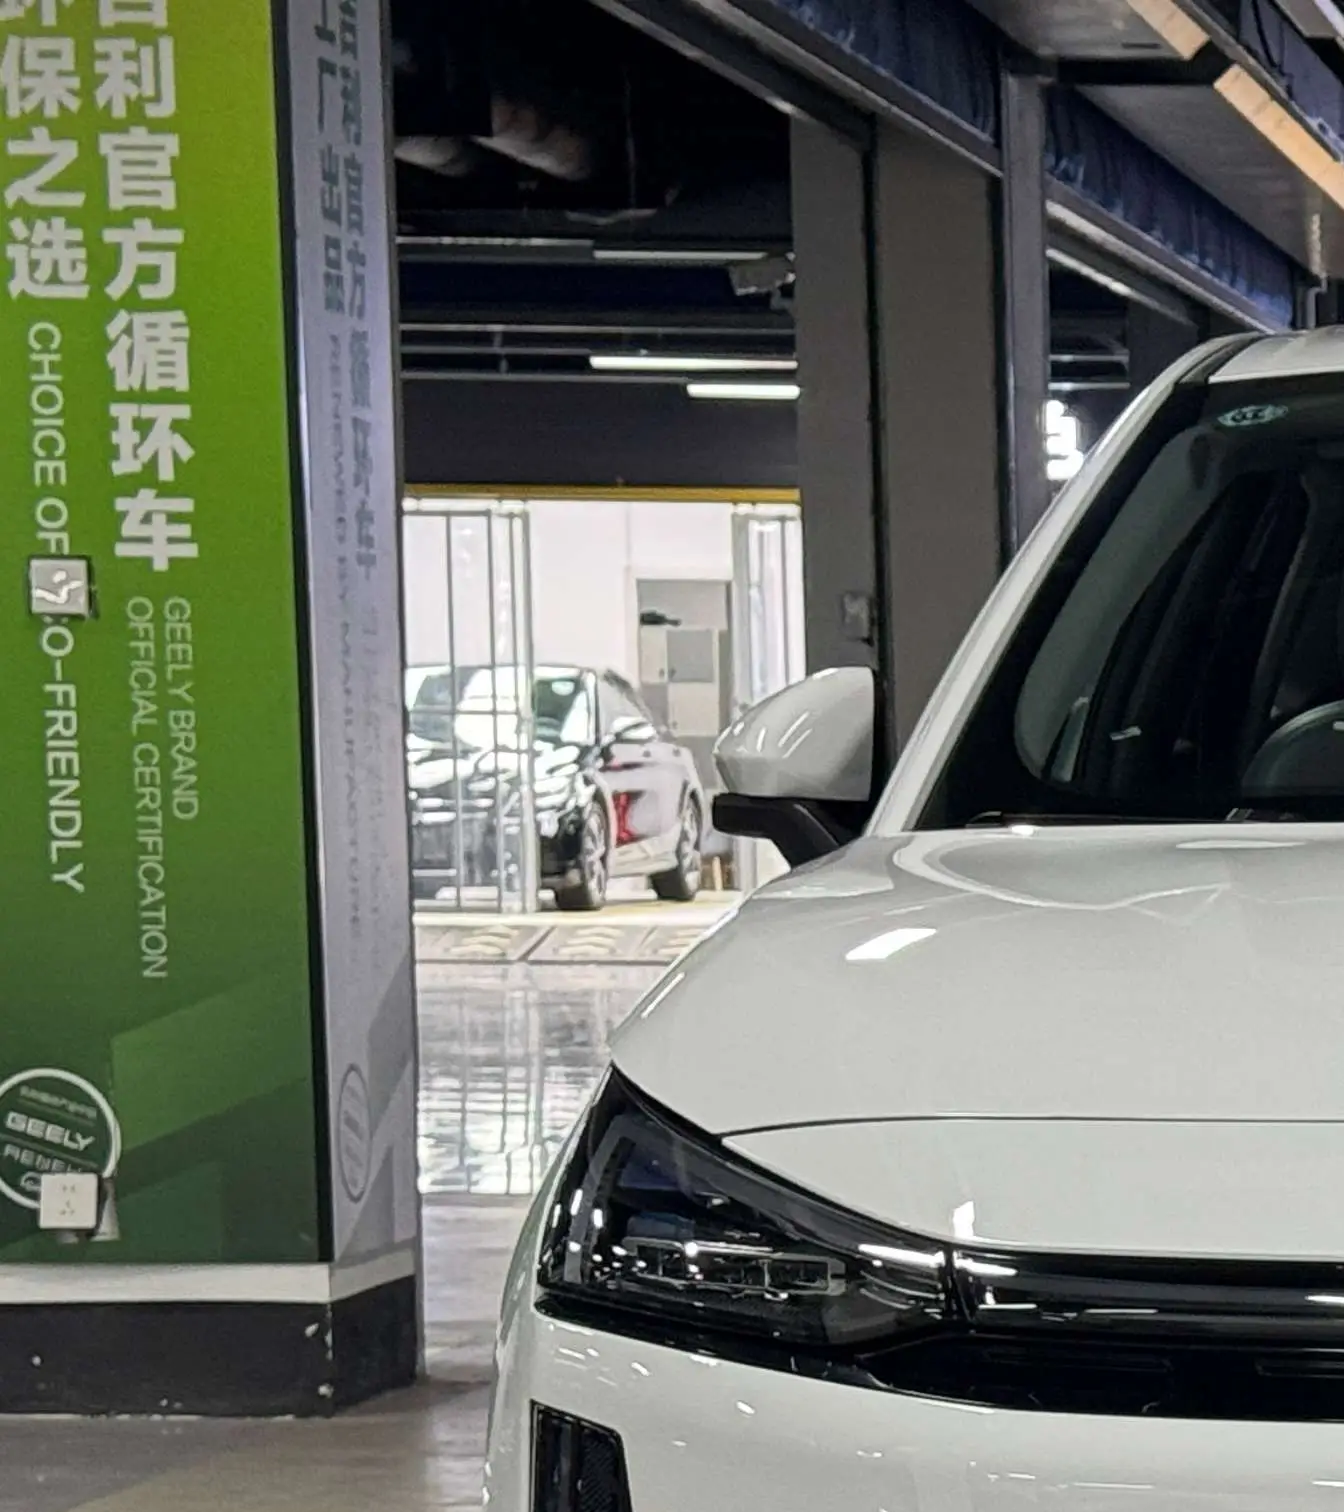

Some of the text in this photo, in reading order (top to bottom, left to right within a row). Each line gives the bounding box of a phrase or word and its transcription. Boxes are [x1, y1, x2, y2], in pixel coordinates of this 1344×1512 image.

[27, 322, 85, 893] CHOICE OF O-FRIENDLY
[164, 596, 199, 821] GEELY BRAND
[126, 596, 168, 979] OFFICIAL CERTIFICATION
[3, 1143, 83, 1173] RENE
[5, 1111, 96, 1152] GEELY
